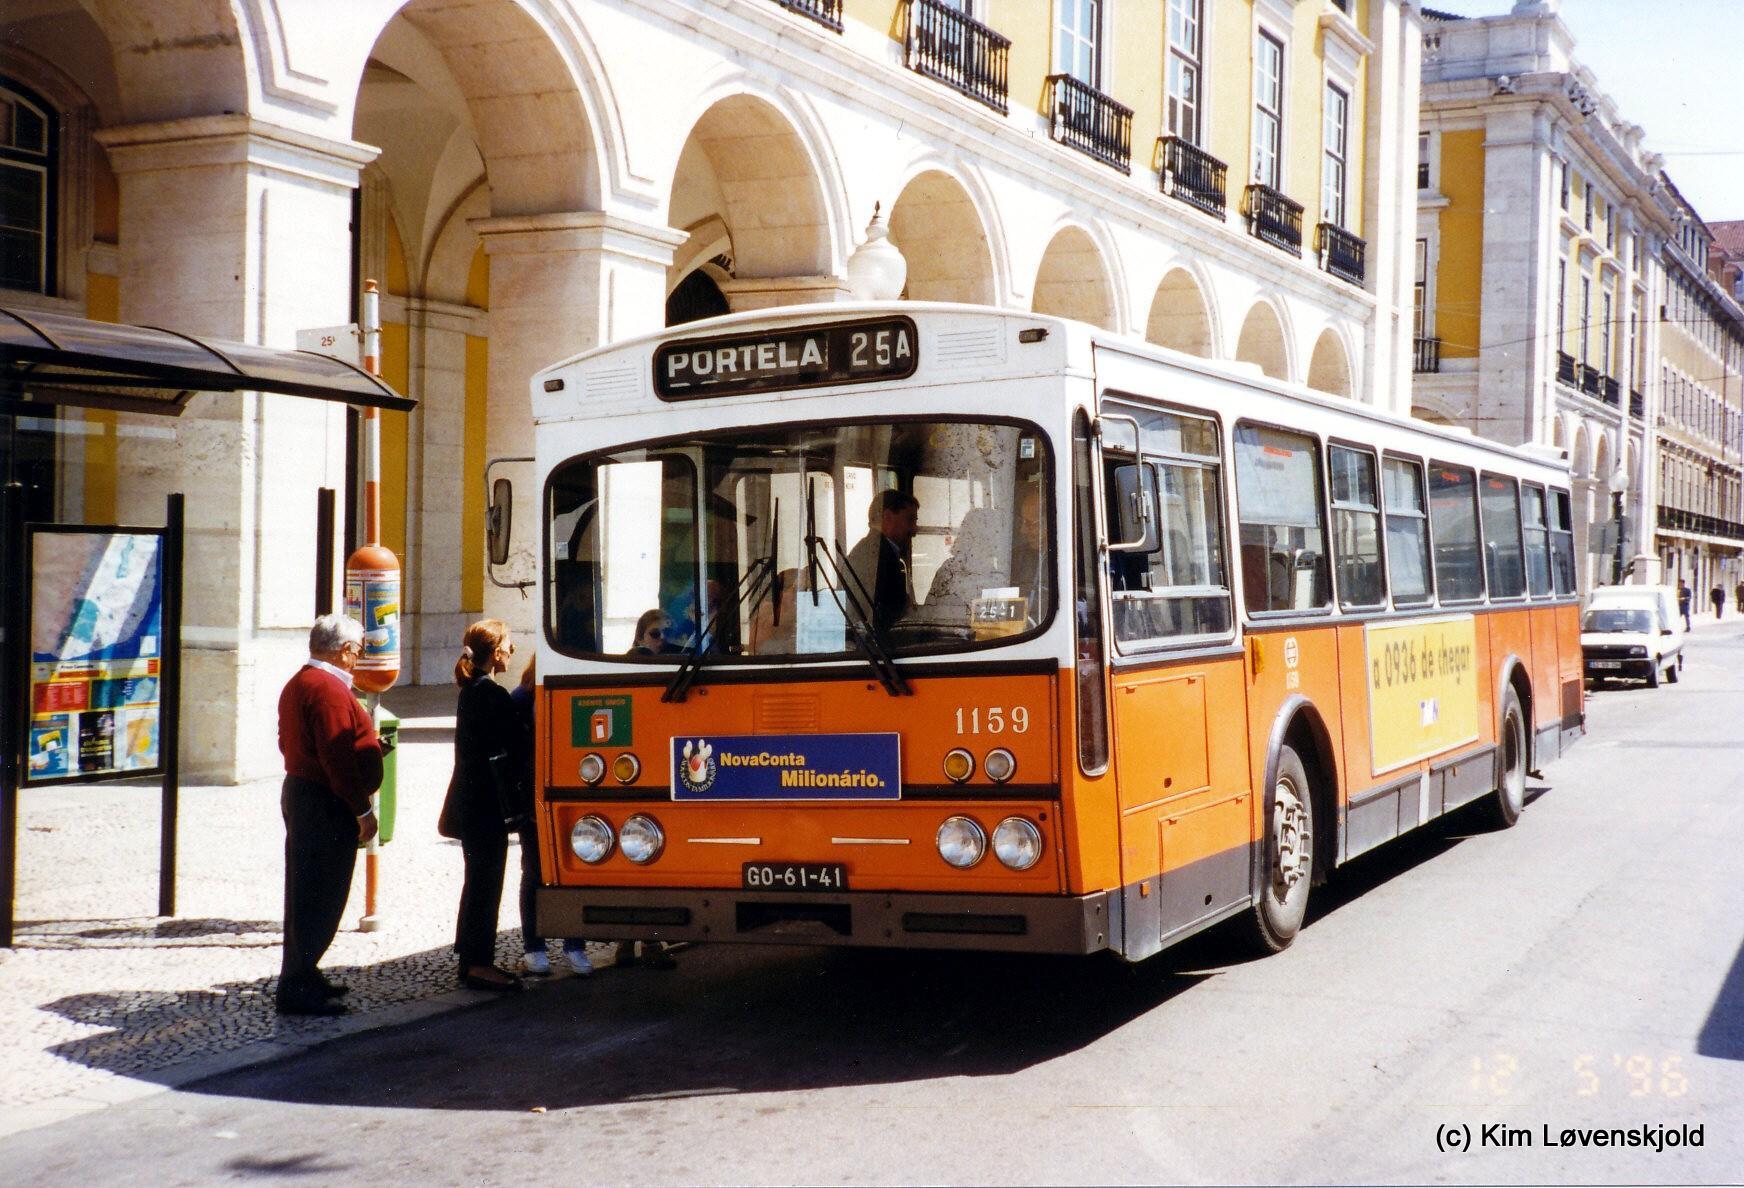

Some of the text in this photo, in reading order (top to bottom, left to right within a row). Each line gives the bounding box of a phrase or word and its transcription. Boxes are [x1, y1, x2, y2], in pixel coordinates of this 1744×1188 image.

[668, 329, 911, 378] PORTELA 25A
[1385, 639, 1417, 688] 0936
[1421, 634, 1434, 680] de
[955, 706, 1030, 734] 1159
[720, 752, 806, 767] NovaConta
[781, 769, 885, 788] Milionário.
[747, 866, 841, 887] GO-61-41
